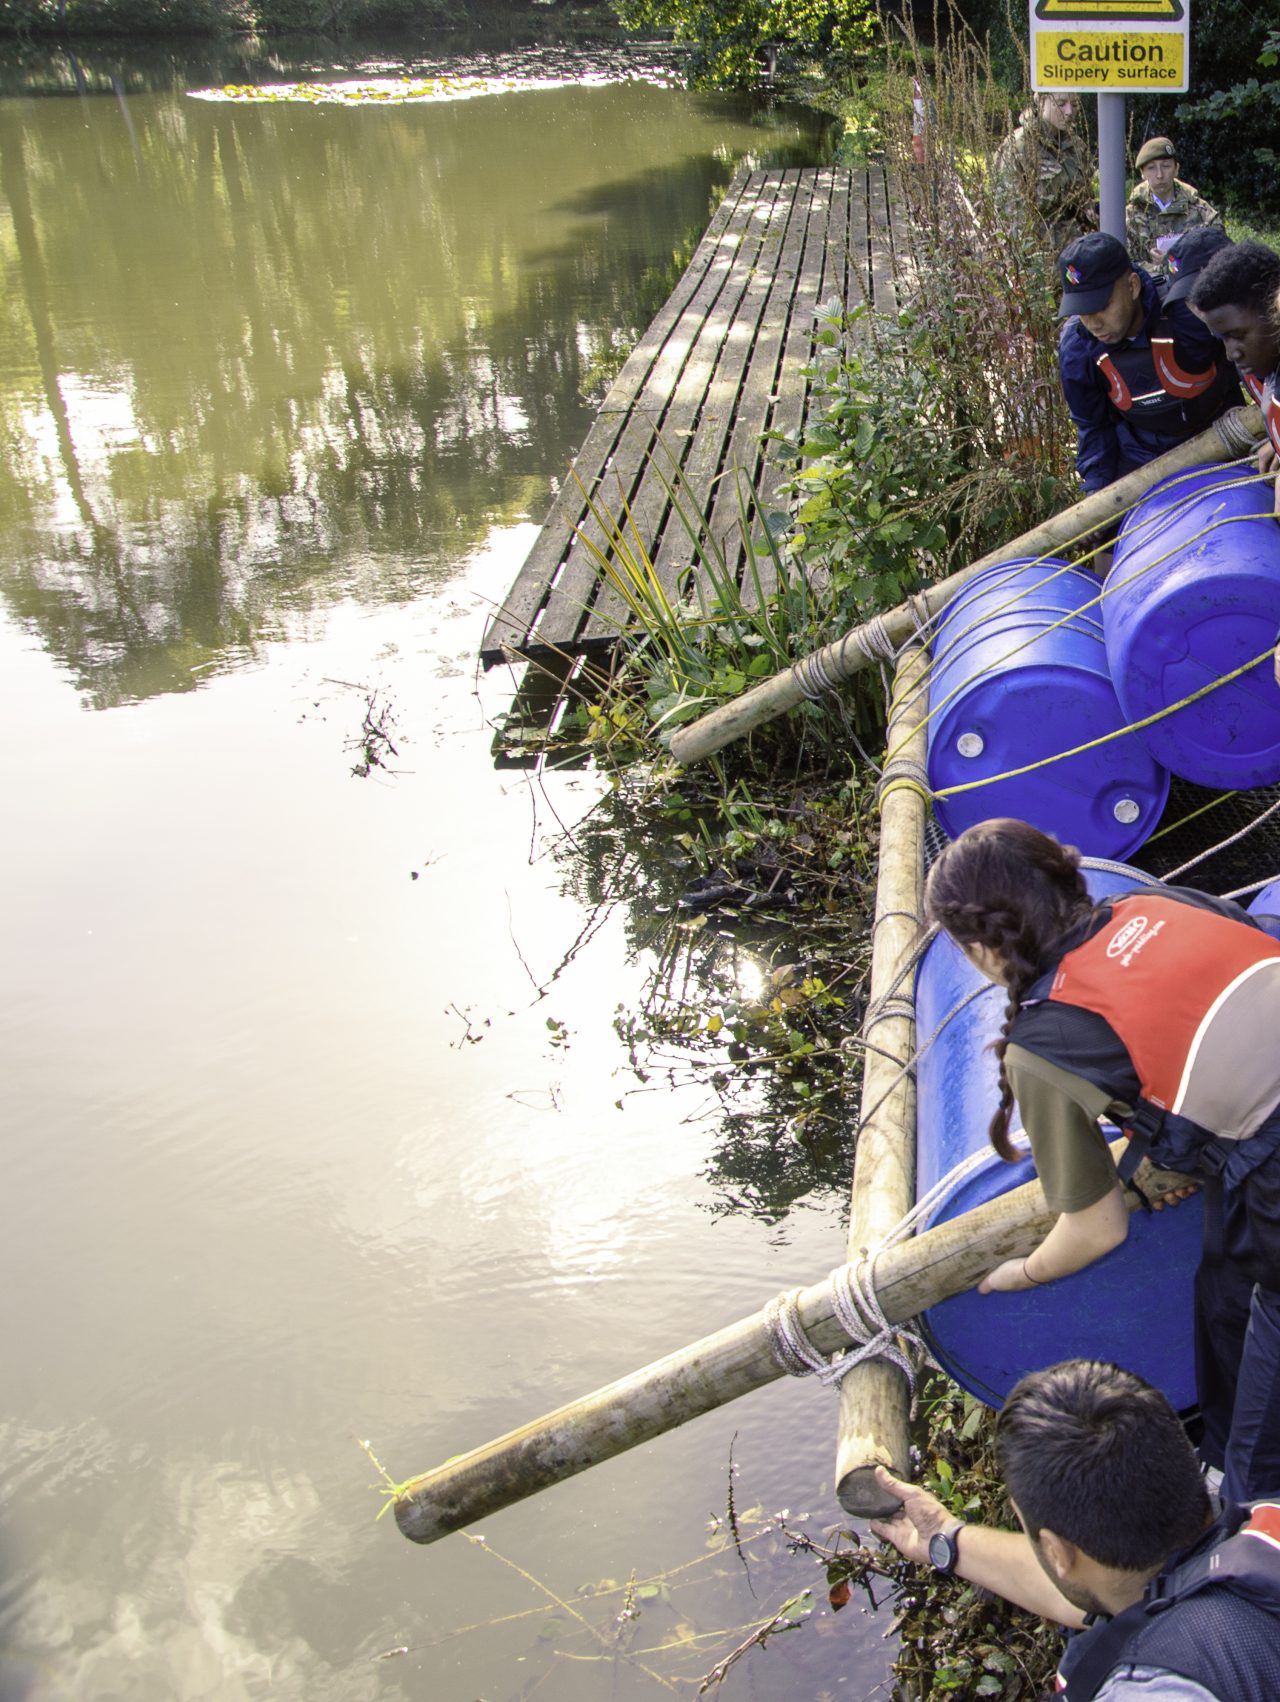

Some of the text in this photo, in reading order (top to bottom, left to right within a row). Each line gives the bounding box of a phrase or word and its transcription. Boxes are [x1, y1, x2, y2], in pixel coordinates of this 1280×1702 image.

[1057, 38, 1164, 62] Caution
[1043, 64, 1177, 81] Slippery surface
